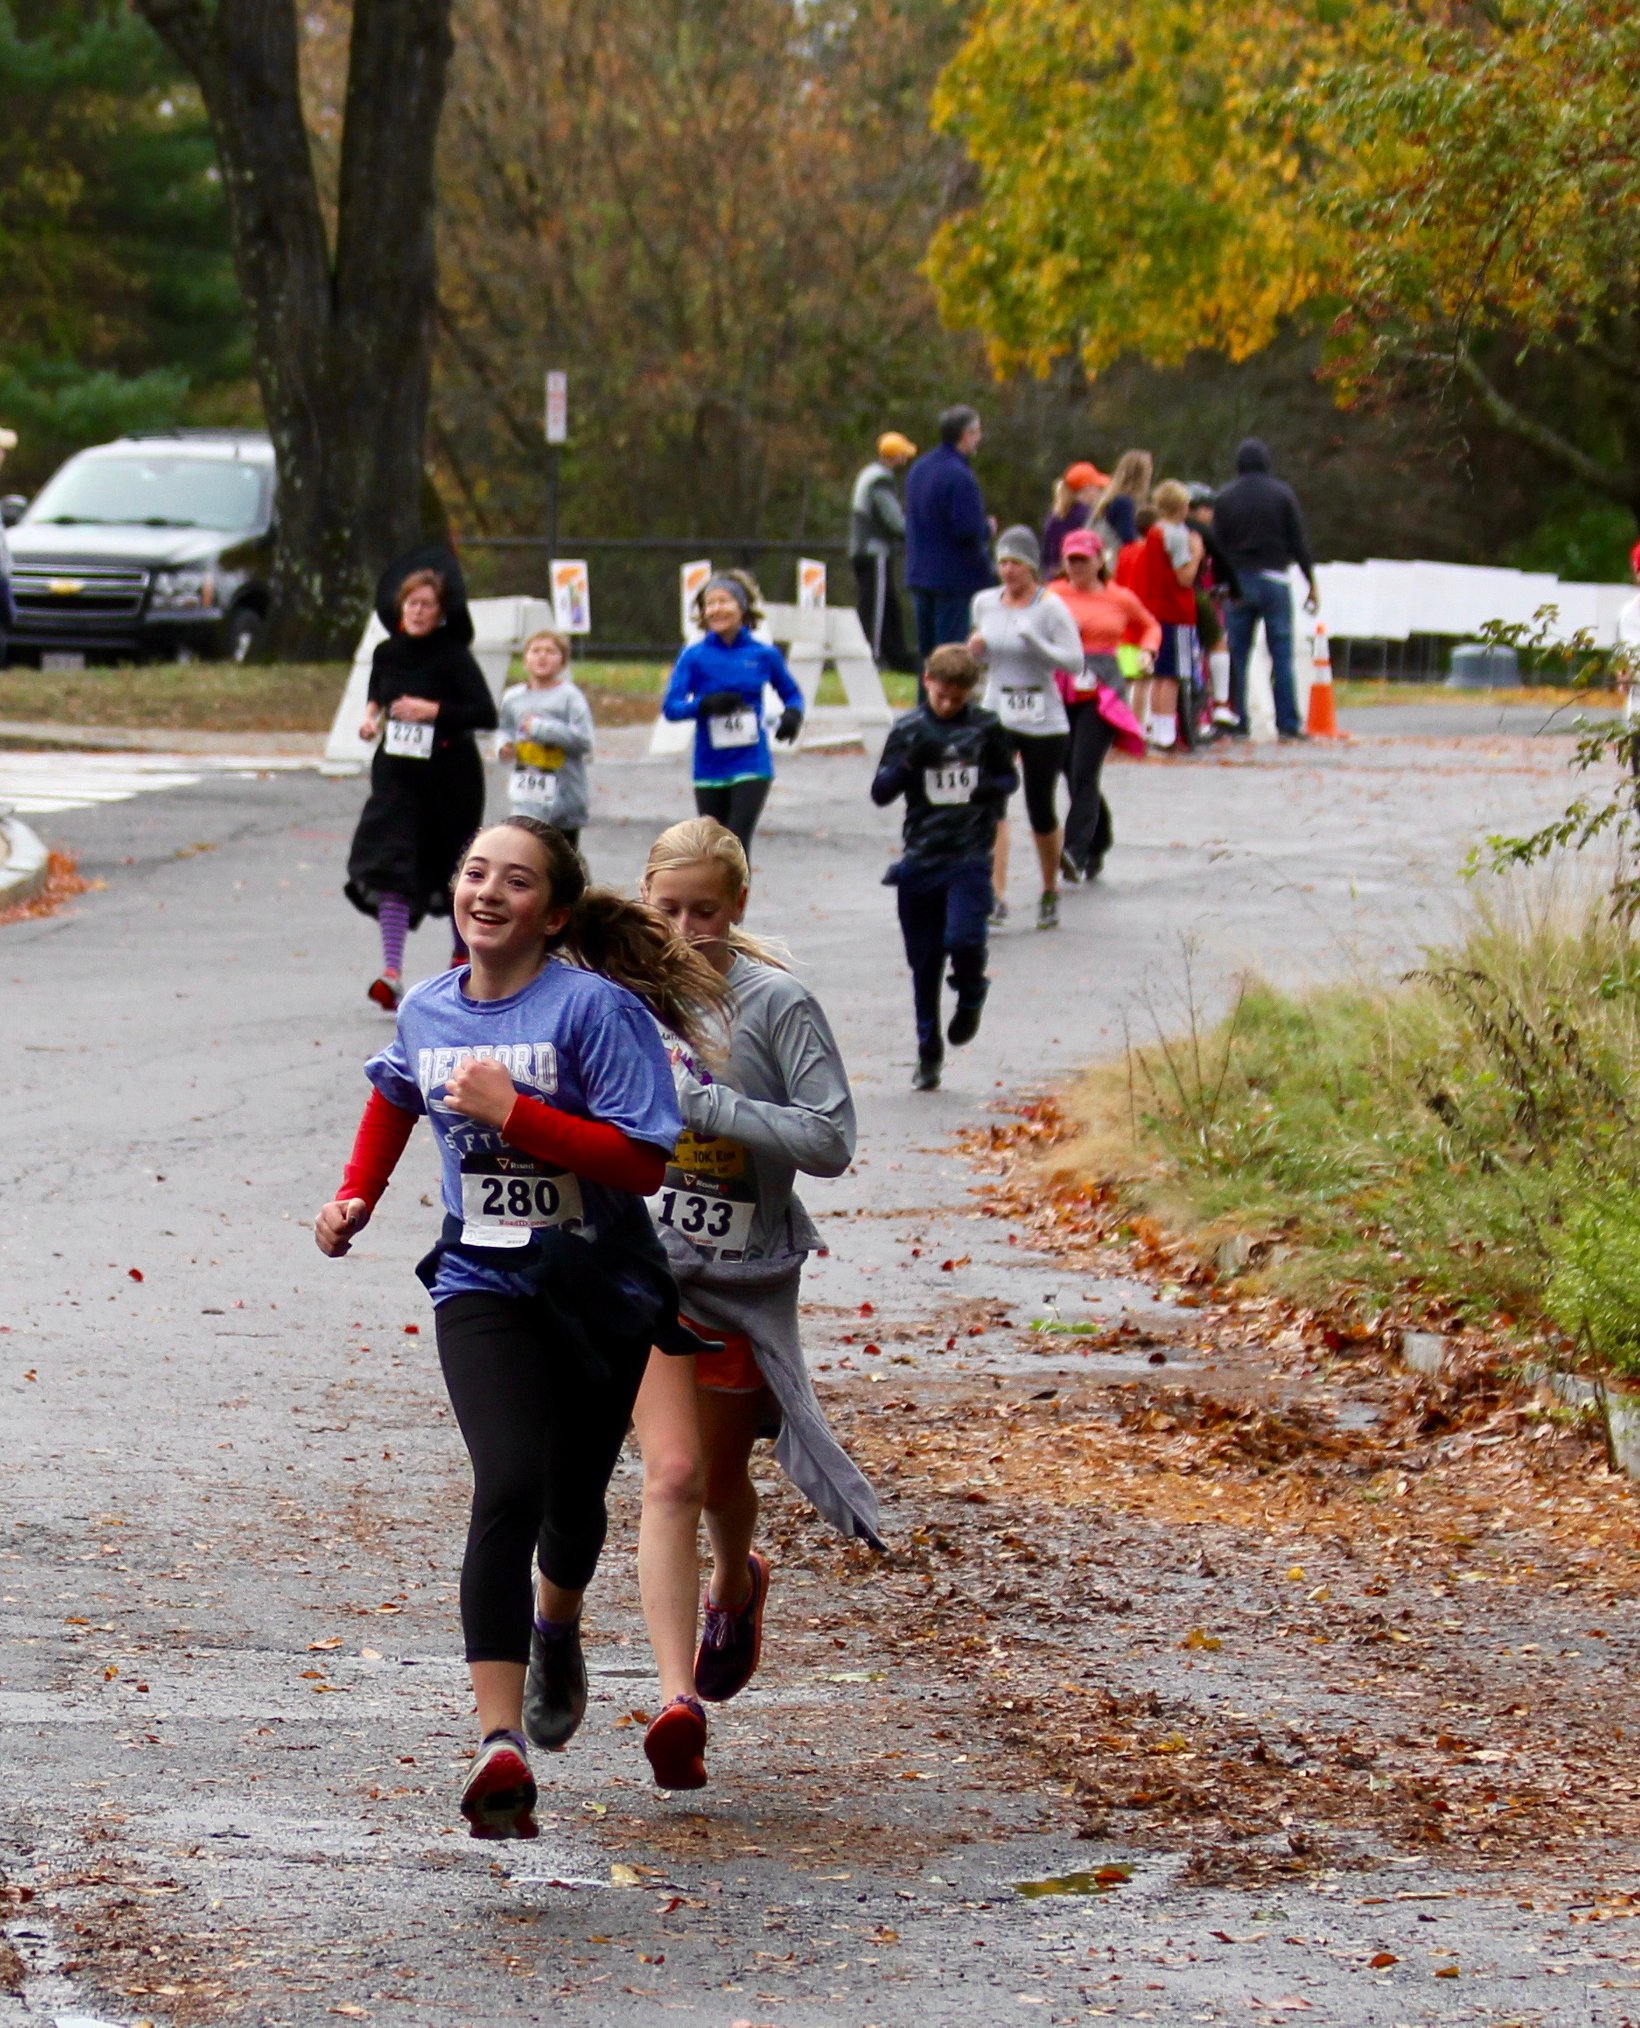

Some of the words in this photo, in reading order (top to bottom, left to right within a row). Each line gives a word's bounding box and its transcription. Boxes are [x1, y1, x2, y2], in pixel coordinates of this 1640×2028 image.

[1007, 693, 1036, 710] 436
[393, 723, 423, 744] 273
[725, 717, 744, 732] 46
[936, 770, 970, 790] 116
[693, 1150, 713, 1164] 10K
[715, 1151, 737, 1164] Run
[481, 1177, 560, 1217] 280
[658, 1191, 733, 1237] 133
